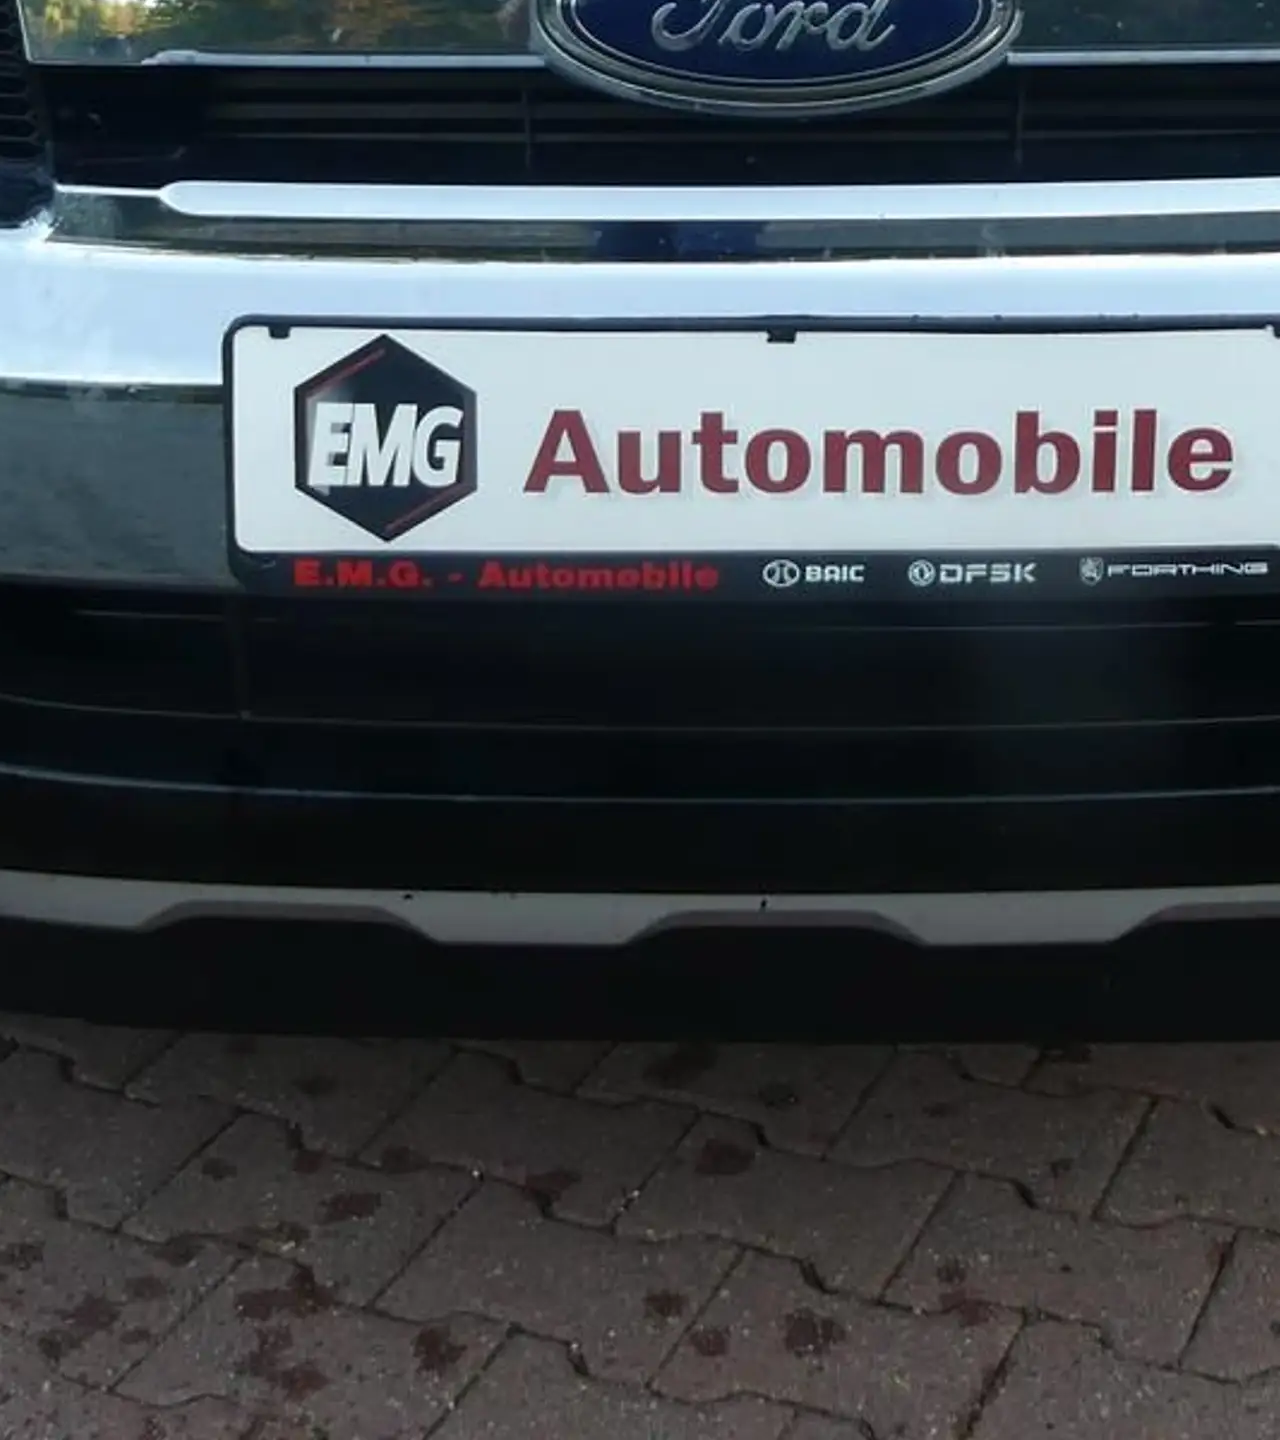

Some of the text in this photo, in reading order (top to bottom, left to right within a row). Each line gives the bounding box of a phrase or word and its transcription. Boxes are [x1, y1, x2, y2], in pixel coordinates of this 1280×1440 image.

[308, 401, 464, 488] EMG
[523, 409, 1235, 495] Automobile
[293, 559, 433, 588] E.M.G.
[477, 560, 719, 590] Automobile
[804, 564, 866, 583] BAIC
[939, 562, 1037, 584] DFSK
[1107, 561, 1269, 577] FORTHING
